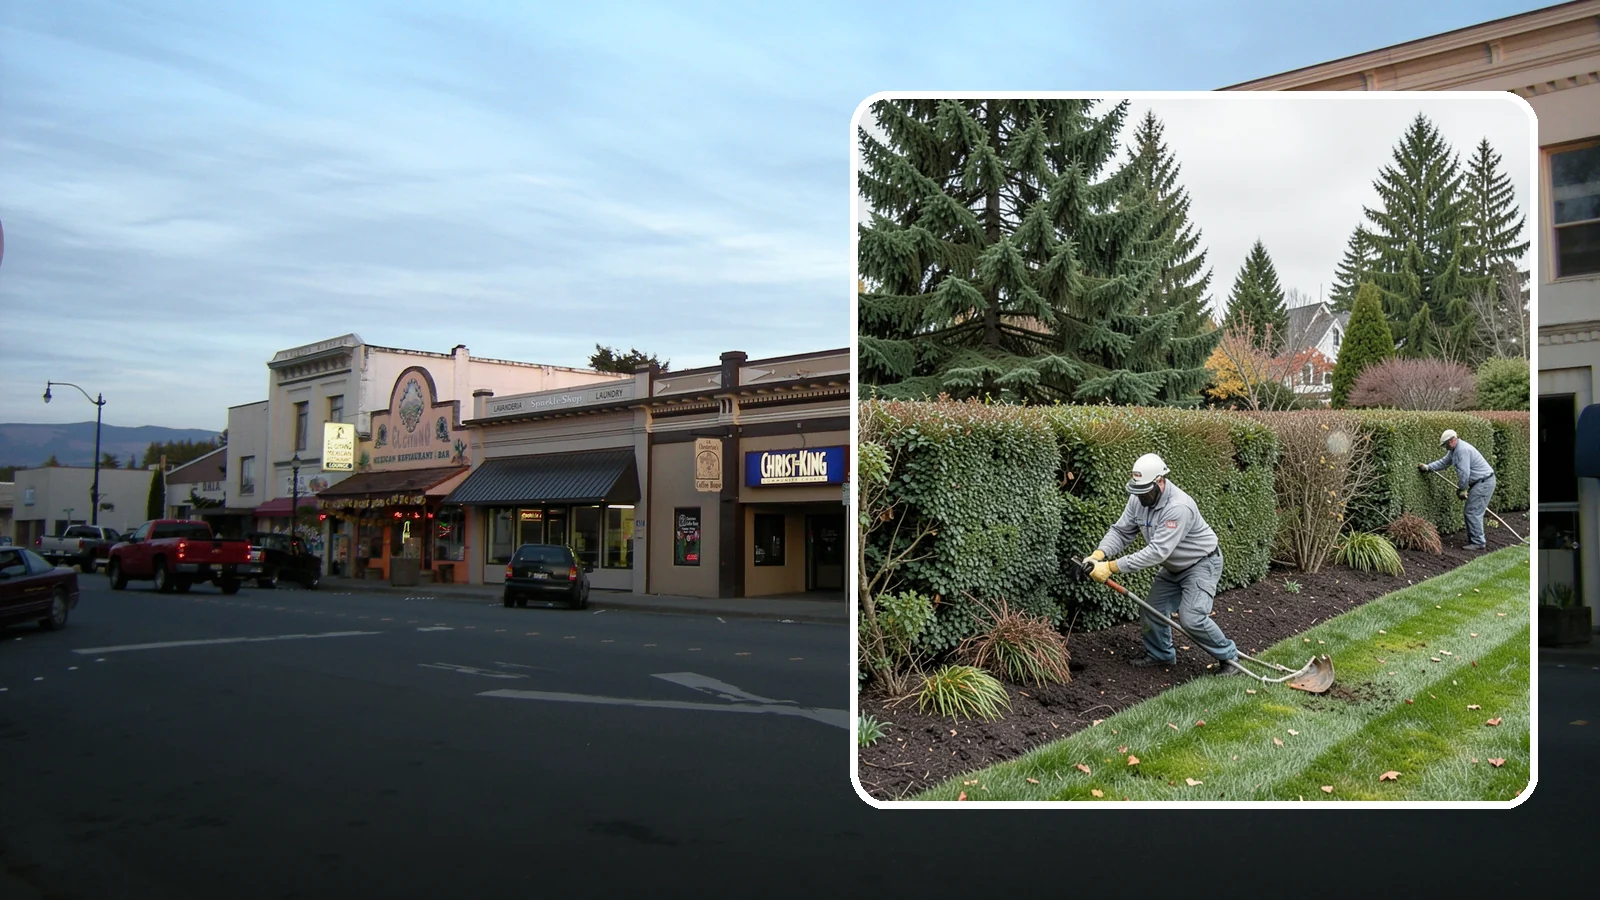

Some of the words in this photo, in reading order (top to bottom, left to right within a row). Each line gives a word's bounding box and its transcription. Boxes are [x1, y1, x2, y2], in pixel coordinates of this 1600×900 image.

[530, 396, 561, 409] Sparkle
[562, 394, 583, 405] Shop
[595, 389, 624, 400] LAUNDRY
[493, 402, 523, 413] LAVANDERIA
[373, 454, 396, 464] MEXICAN
[397, 451, 434, 462] RESTAURANT
[437, 450, 450, 459] BAR
[761, 452, 797, 478] CHRIST
[799, 450, 828, 476] KING
